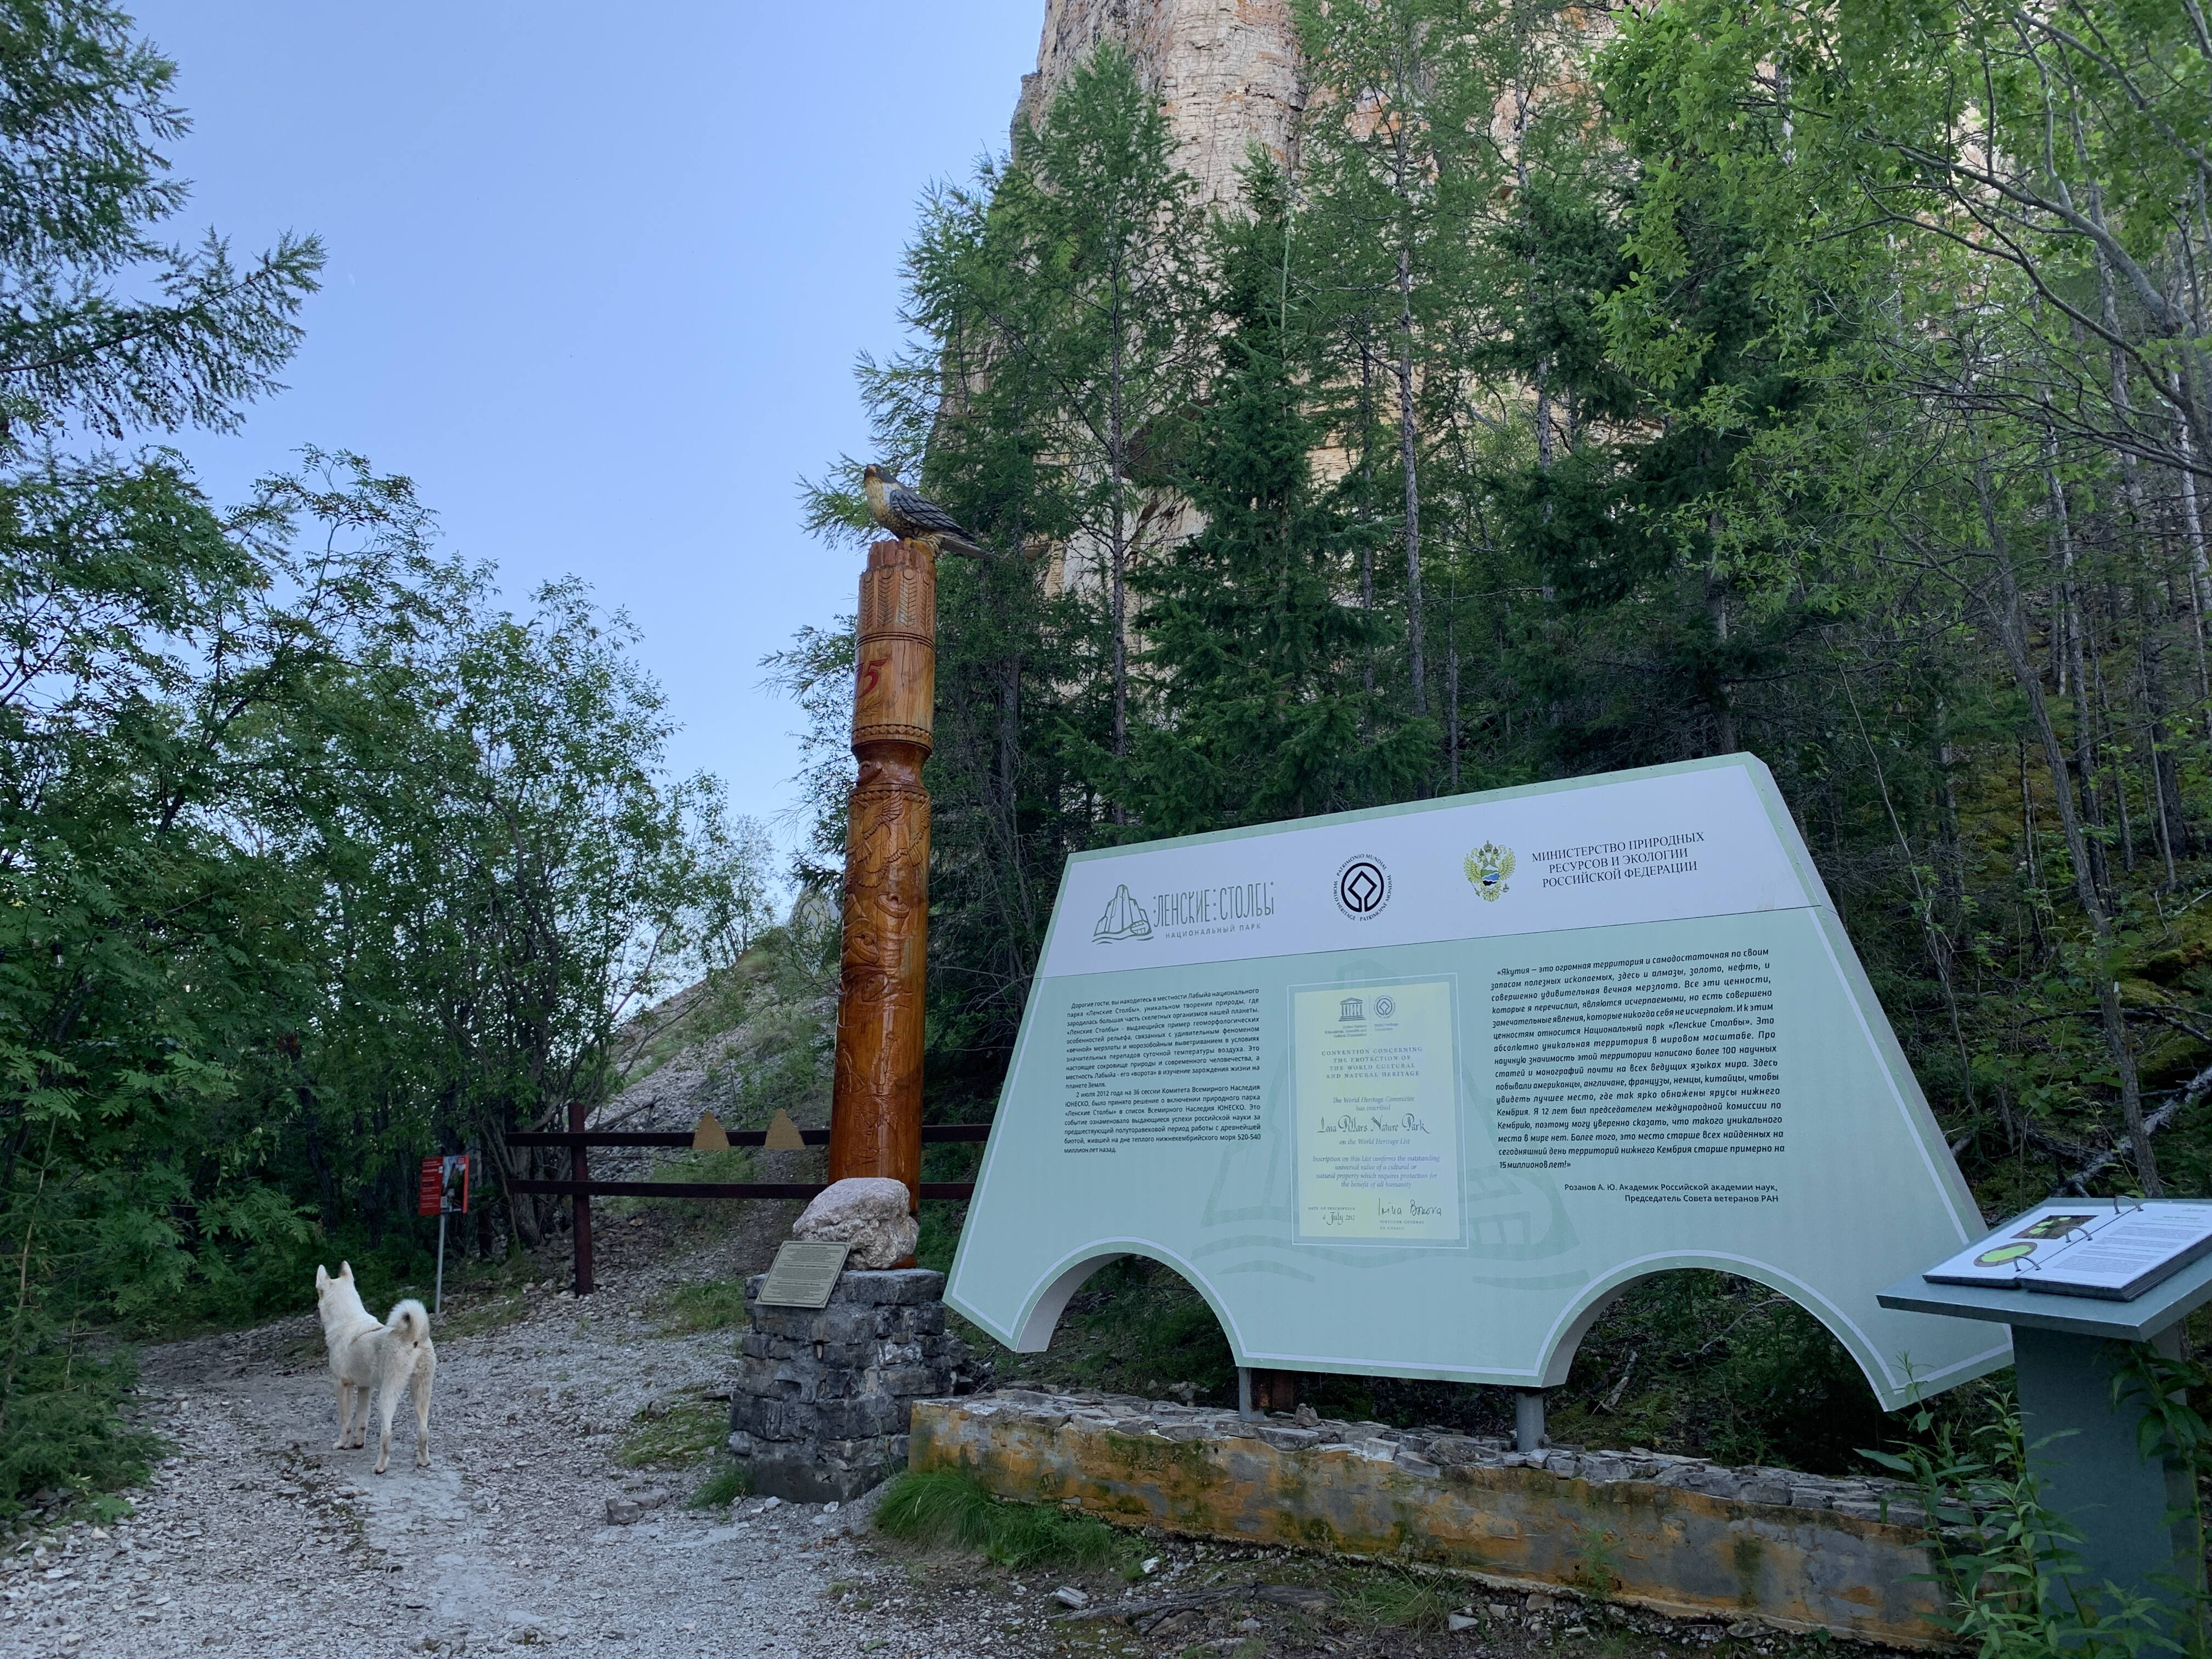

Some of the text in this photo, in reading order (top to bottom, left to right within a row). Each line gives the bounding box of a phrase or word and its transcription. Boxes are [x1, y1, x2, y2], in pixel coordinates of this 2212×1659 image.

[1532, 832, 1704, 861] МИНИСТЕРСТВО ПРИРОДНЫХ
[1336, 853, 1387, 877] PATRIMONIO MUNDIAL
[1549, 848, 1687, 873] РЕСУРСОВ И ЭКОЛОГИИ
[1543, 861, 1697, 887] РОССИЙСКОЙ ФЕДЕРАЦИИ
[1336, 902, 1356, 921] HERITAGE
[1359, 902, 1387, 922] PATRIMOINE
[1165, 926, 1234, 939] НАЦИОНАЛЬНЫЙ
[1491, 992, 1537, 1001] совершенно
[1541, 988, 1599, 1000] удивительная
[1635, 983, 1680, 992] мерзлота.
[1724, 977, 1770, 986] ценности,
[1144, 1004, 1180, 1013] уникальном
[1172, 1011, 1207, 1019] организмов
[1493, 1031, 1534, 1040] ценностям
[1584, 1023, 1642, 1034] Национальный
[1646, 1022, 1664, 1031] парк
[1669, 1020, 1706, 1030] «Ленские
[1710, 1018, 1752, 1027] Столбы».
[1756, 1017, 1774, 1025] Это
[1494, 1030, 1775, 1052] абсолютно уникальная территория в мировом масштабе. Про
[1143, 1049, 1171, 1058] суточной
[1494, 1056, 1526, 1066] научную
[1528, 1056, 1575, 1065] значимость
[1577, 1052, 1597, 1060] этой
[1600, 1052, 1651, 1061] территории
[1695, 1047, 1719, 1055] более
[1739, 1046, 1776, 1055] научных
[1496, 1082, 1532, 1090] побывали
[1533, 1080, 1582, 1090] американцы,
[1628, 1077, 1671, 1087] французы,
[1705, 1074, 1746, 1082] китайцы,
[1748, 1072, 1779, 1081] чтобы
[1194, 1114, 1229, 1122] российской
[1317, 1113, 1430, 1134] Lena Pillars Nature Park
[1373, 1155, 1396, 1163] confirms
[1625, 1195, 1681, 1203] Председатель
